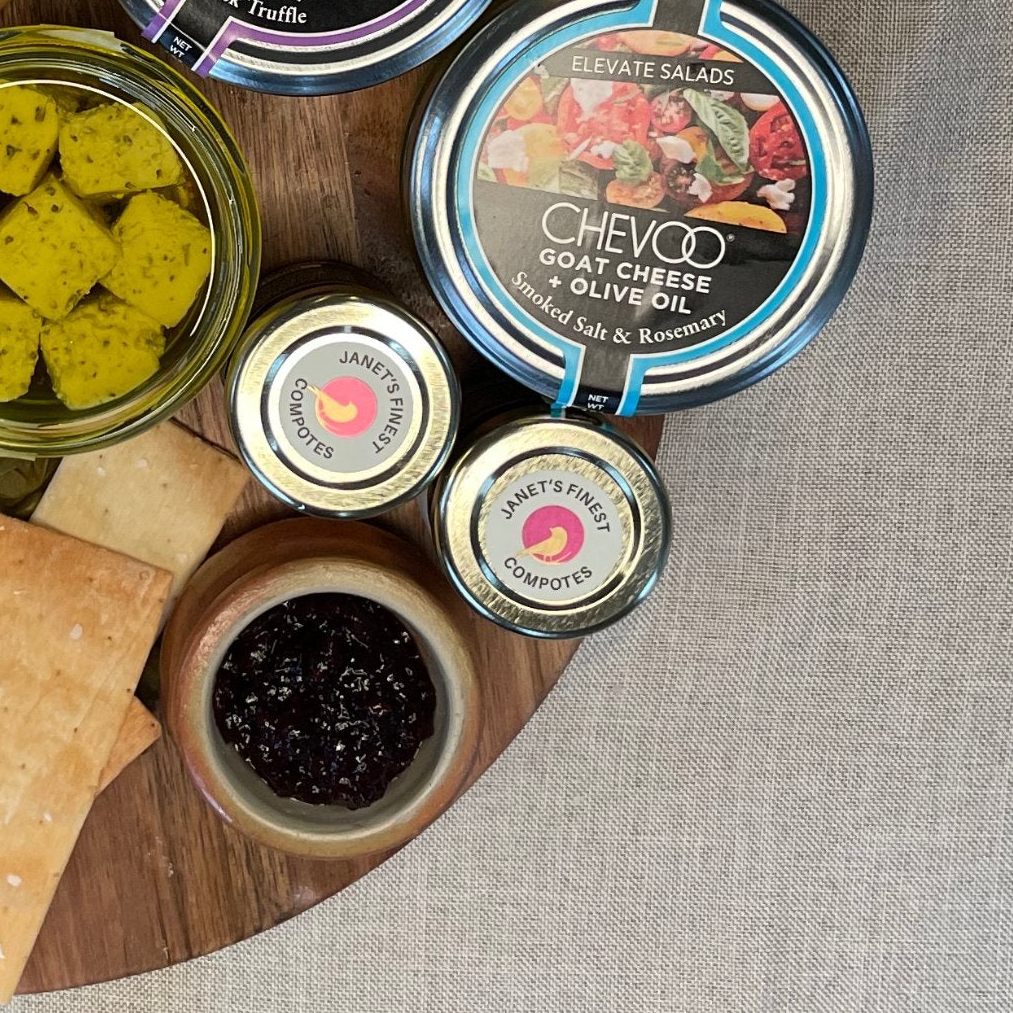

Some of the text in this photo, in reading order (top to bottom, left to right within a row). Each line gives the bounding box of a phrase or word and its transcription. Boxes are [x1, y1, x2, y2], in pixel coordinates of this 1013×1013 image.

[170, 45, 185, 58] WT
[173, 36, 192, 51] NET
[571, 55, 735, 86] ELEVATE SALADS
[541, 201, 726, 269] CHEVOO
[539, 248, 712, 295] GOAT CHEESE
[511, 270, 728, 345] Smoked Salt & Rosemary
[548, 275, 692, 315] + OLIVE OIL
[339, 351, 404, 454] JANET'S FINEST
[587, 402, 605, 410] WT
[588, 393, 609, 403] NET
[289, 377, 334, 460] COMPOTES
[500, 479, 610, 533] JANET'S FINEST
[504, 557, 592, 591] COMPOTES
